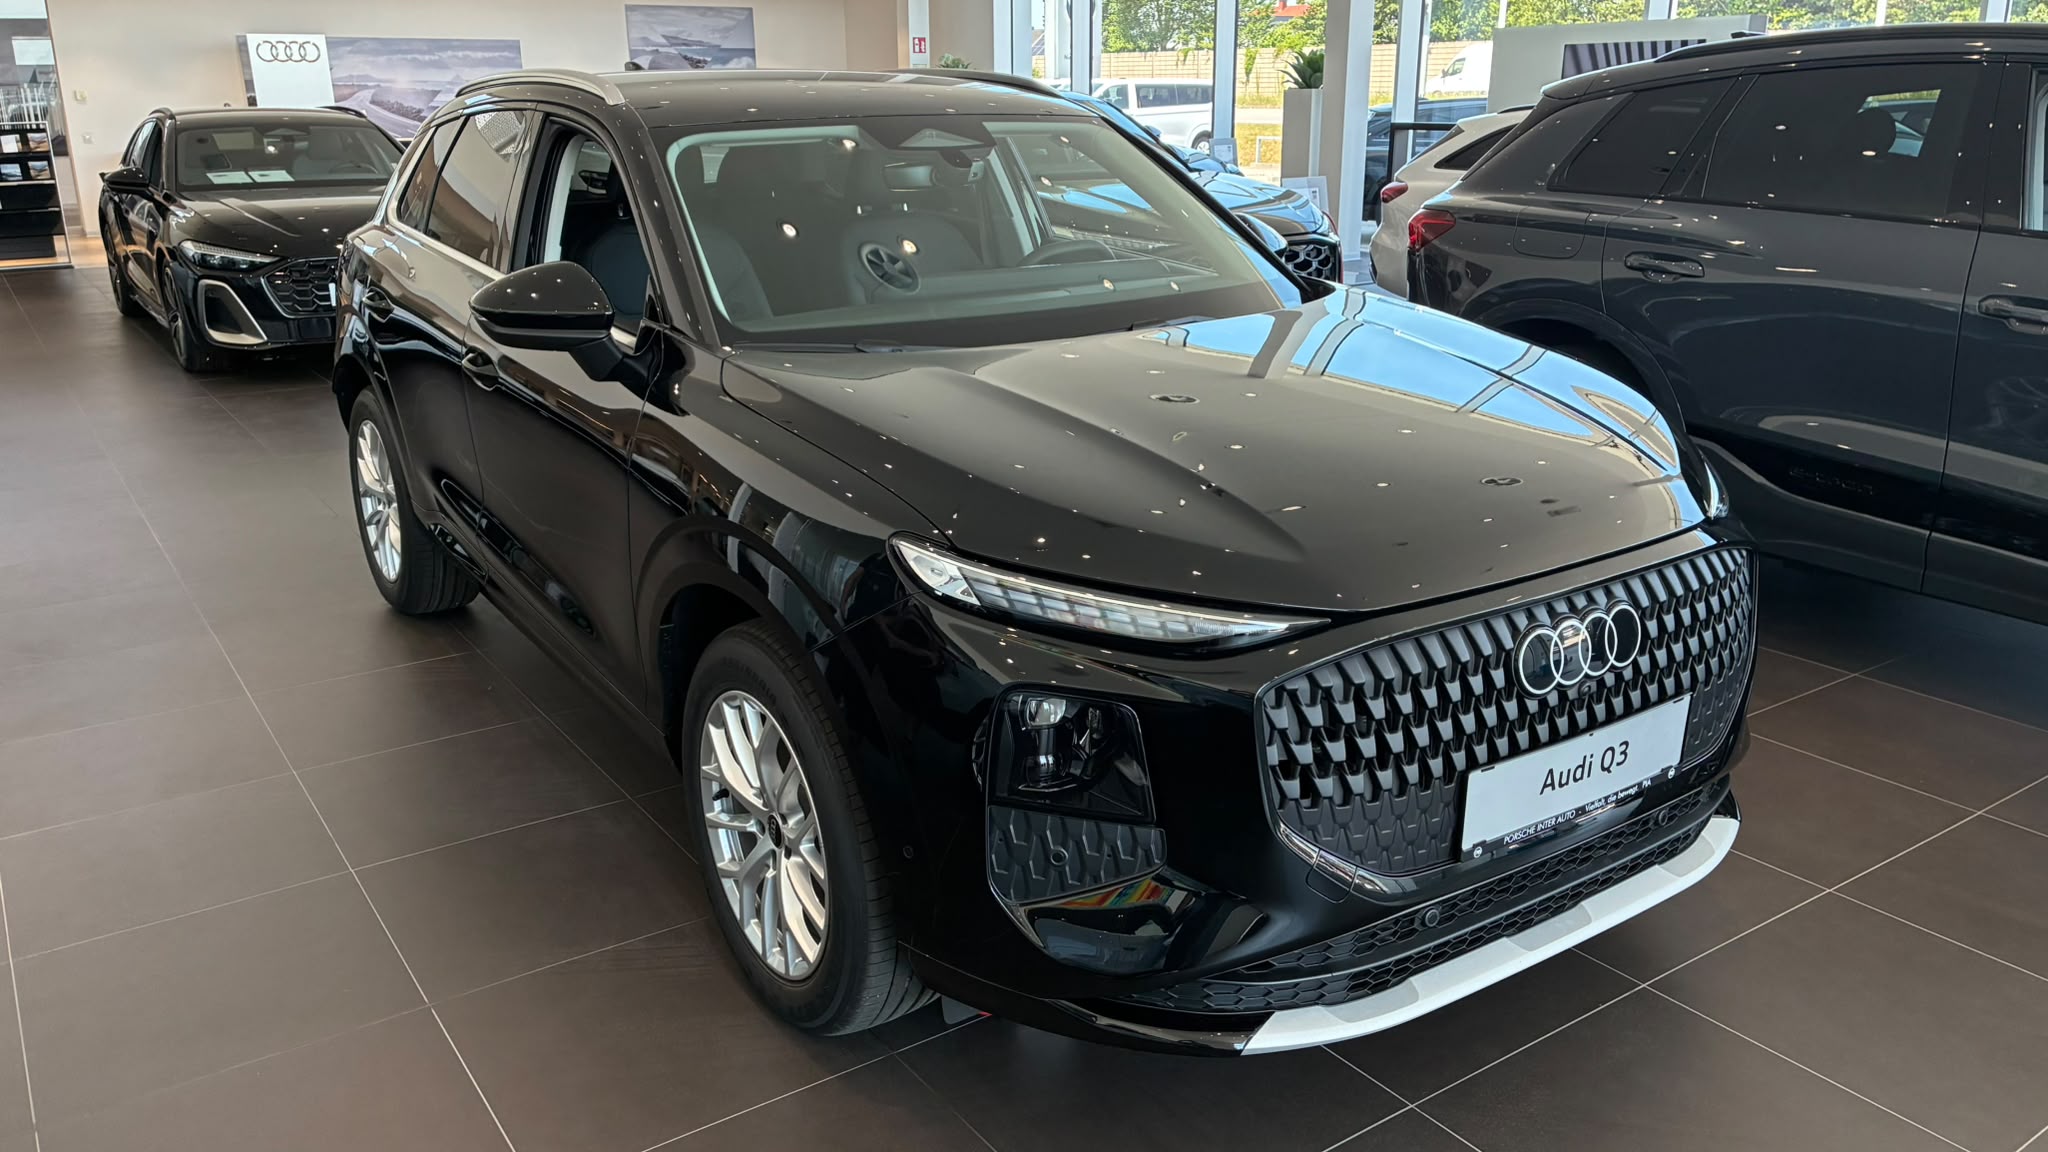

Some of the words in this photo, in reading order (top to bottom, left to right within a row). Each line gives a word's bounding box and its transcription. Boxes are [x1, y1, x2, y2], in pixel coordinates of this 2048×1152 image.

[1540, 753, 1594, 795] Audi
[1600, 740, 1629, 774] Q3
[1503, 827, 1535, 845] PORSCHE
[1536, 817, 1556, 831] INTER
[1556, 810, 1576, 825] AUTO
